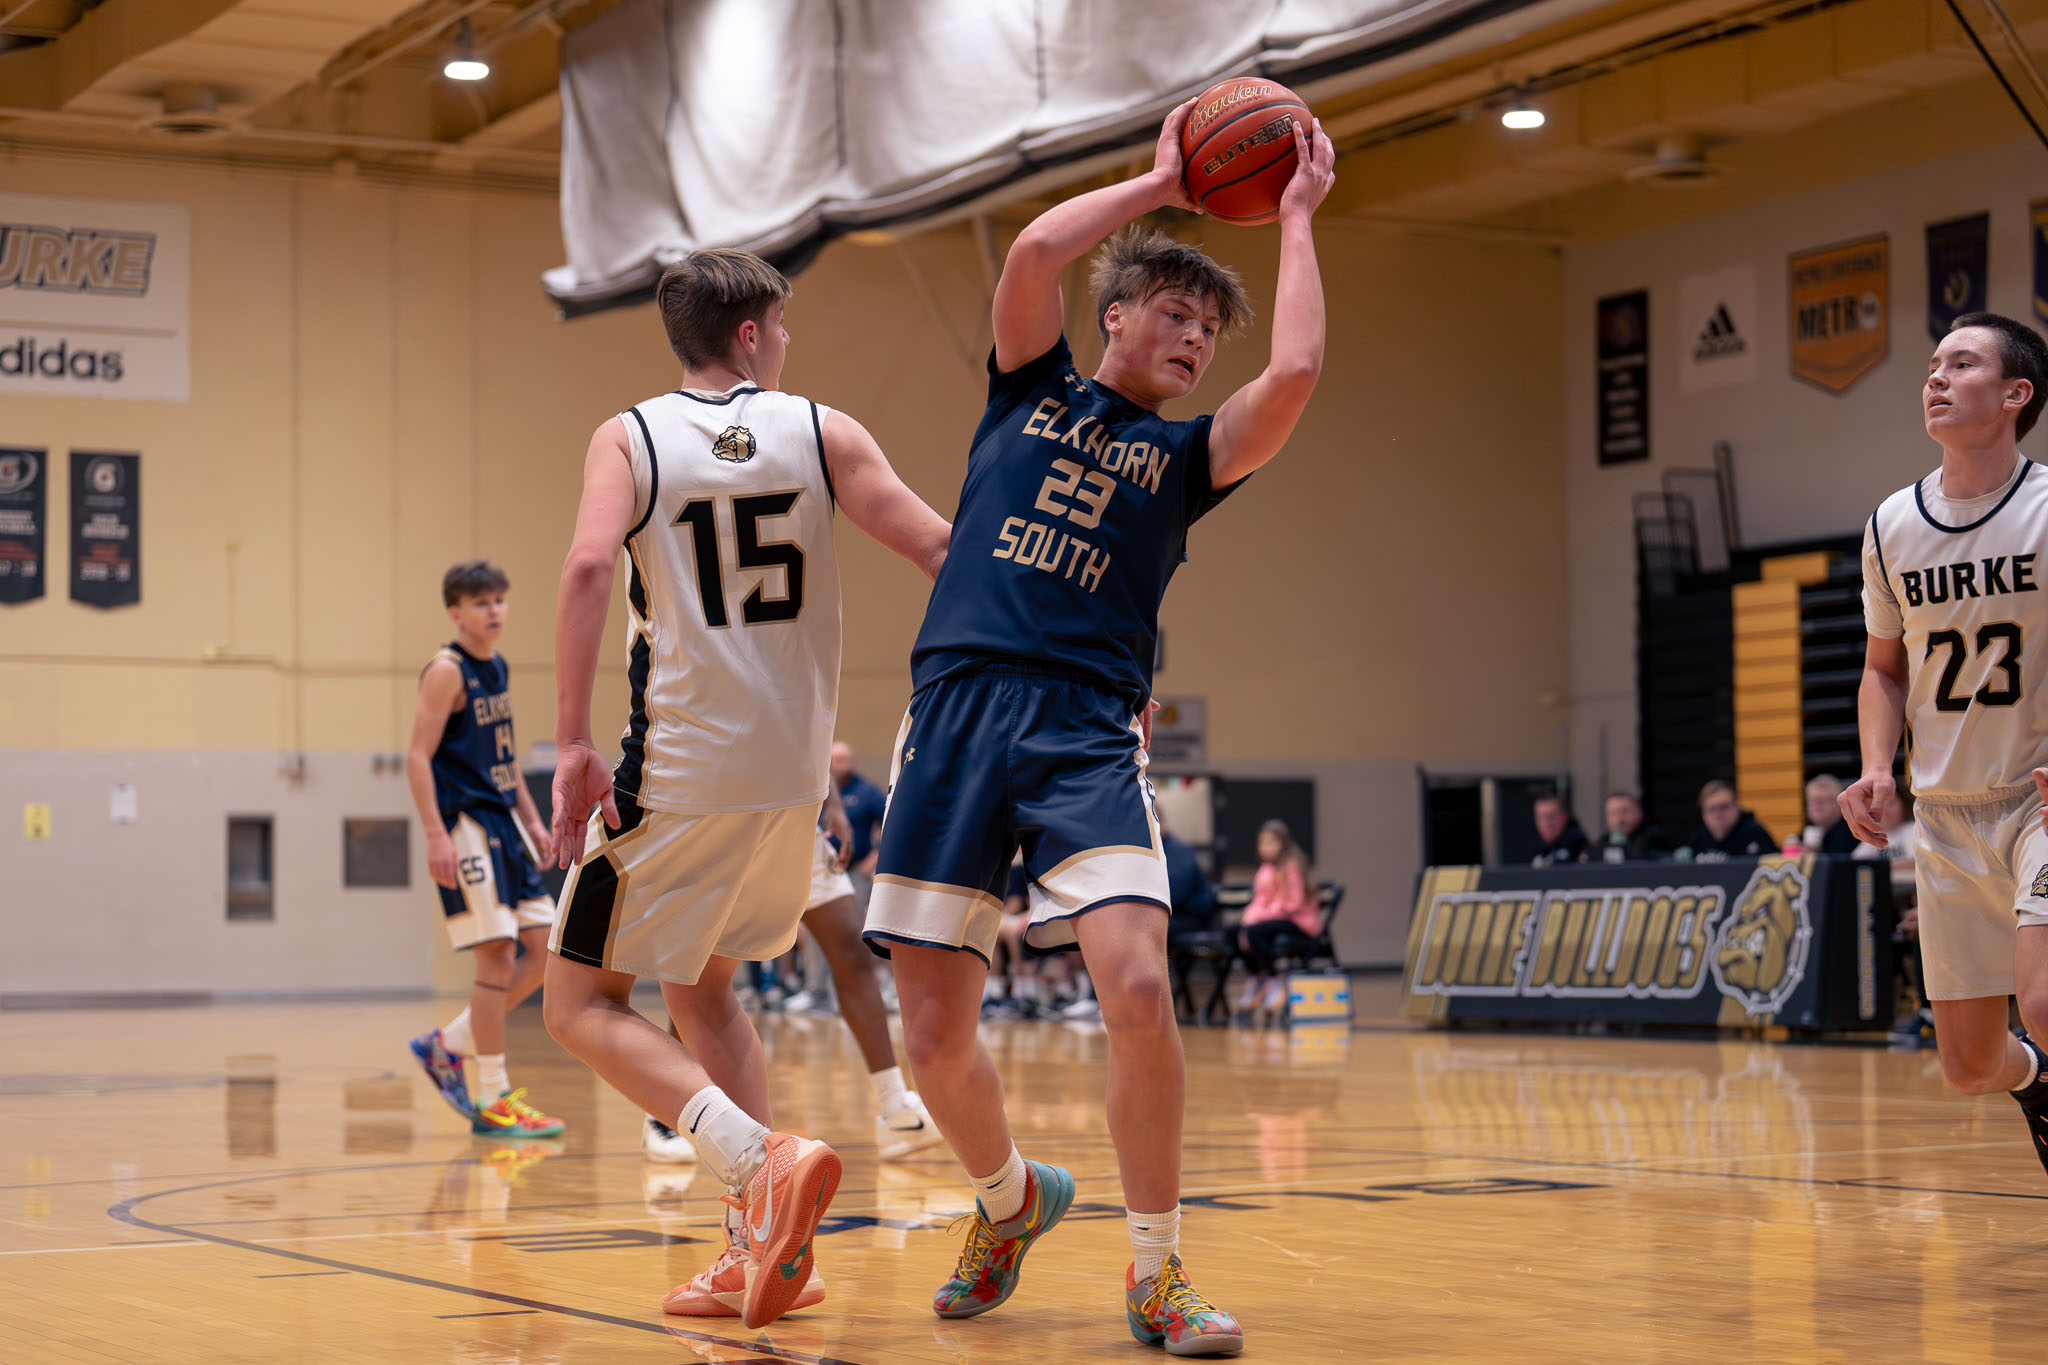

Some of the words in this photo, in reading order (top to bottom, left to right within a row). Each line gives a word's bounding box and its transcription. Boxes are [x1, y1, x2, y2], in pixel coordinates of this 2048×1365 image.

[1190, 83, 1273, 139] Baden
[1202, 128, 1266, 176] ELITE
[1021, 397, 1171, 495] ELKHORN
[1034, 457, 1117, 530] 23
[668, 487, 807, 630] 15
[992, 516, 1111, 593] SOUTH
[1901, 553, 2039, 608] BURKE
[1924, 619, 2024, 713] 23
[1521, 885, 1726, 998] BULLDOGS
